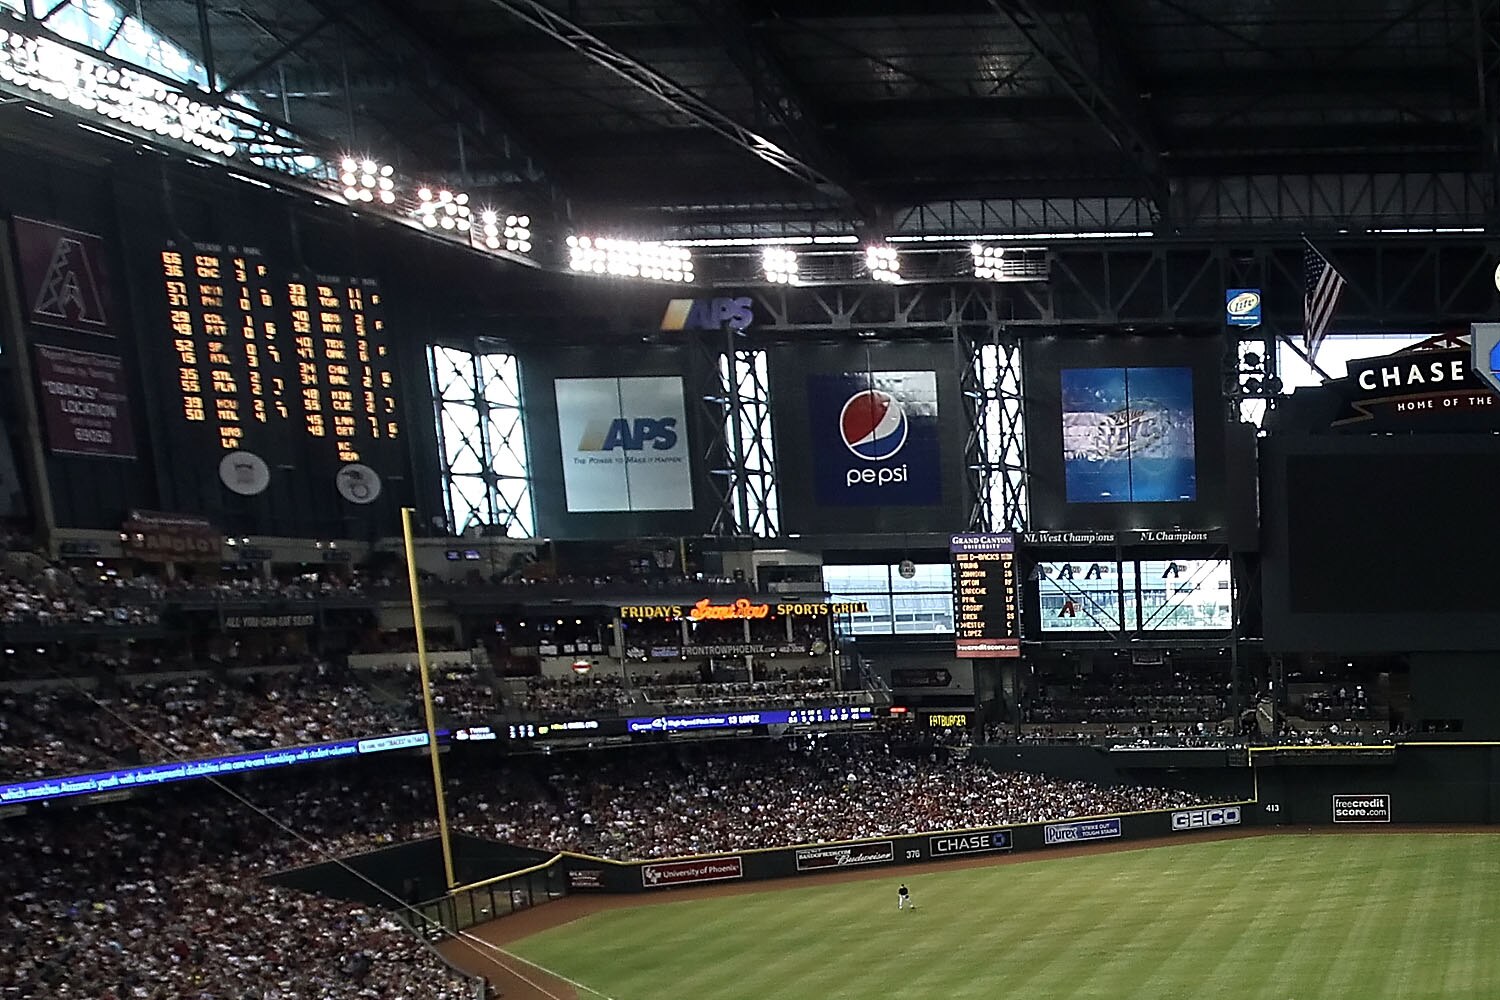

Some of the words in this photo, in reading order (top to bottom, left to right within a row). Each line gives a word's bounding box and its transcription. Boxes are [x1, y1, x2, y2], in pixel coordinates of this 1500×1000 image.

[685, 297, 753, 330] APS
[1359, 361, 1464, 390] CHASE
[1397, 398, 1434, 411] HOME
[1443, 398, 1459, 408] OF
[1469, 397, 1492, 406] THE
[602, 417, 677, 451] APS
[847, 464, 908, 487] pepsi
[952, 536, 979, 544] GRAND
[980, 536, 1012, 544] CANYON
[1024, 534, 1037, 543] NL
[1039, 533, 1061, 542] West
[1063, 533, 1114, 544] Champions
[1141, 532, 1154, 541] NL
[1156, 531, 1207, 543] Champions
[777, 604, 828, 616] SPORTS
[833, 603, 869, 615] GRILL
[739, 715, 760, 724] LOPEZ
[929, 715, 966, 727] FATBURGER
[1335, 799, 1384, 808] freecredit
[1173, 808, 1239, 829] GEICO
[1048, 826, 1079, 843] Purex
[937, 835, 990, 851] CHASE
[835, 851, 891, 865] Budweiser
[906, 850, 921, 859] 376
[663, 868, 699, 879] University
[700, 866, 708, 874] of
[708, 864, 739, 873] Phoenix
